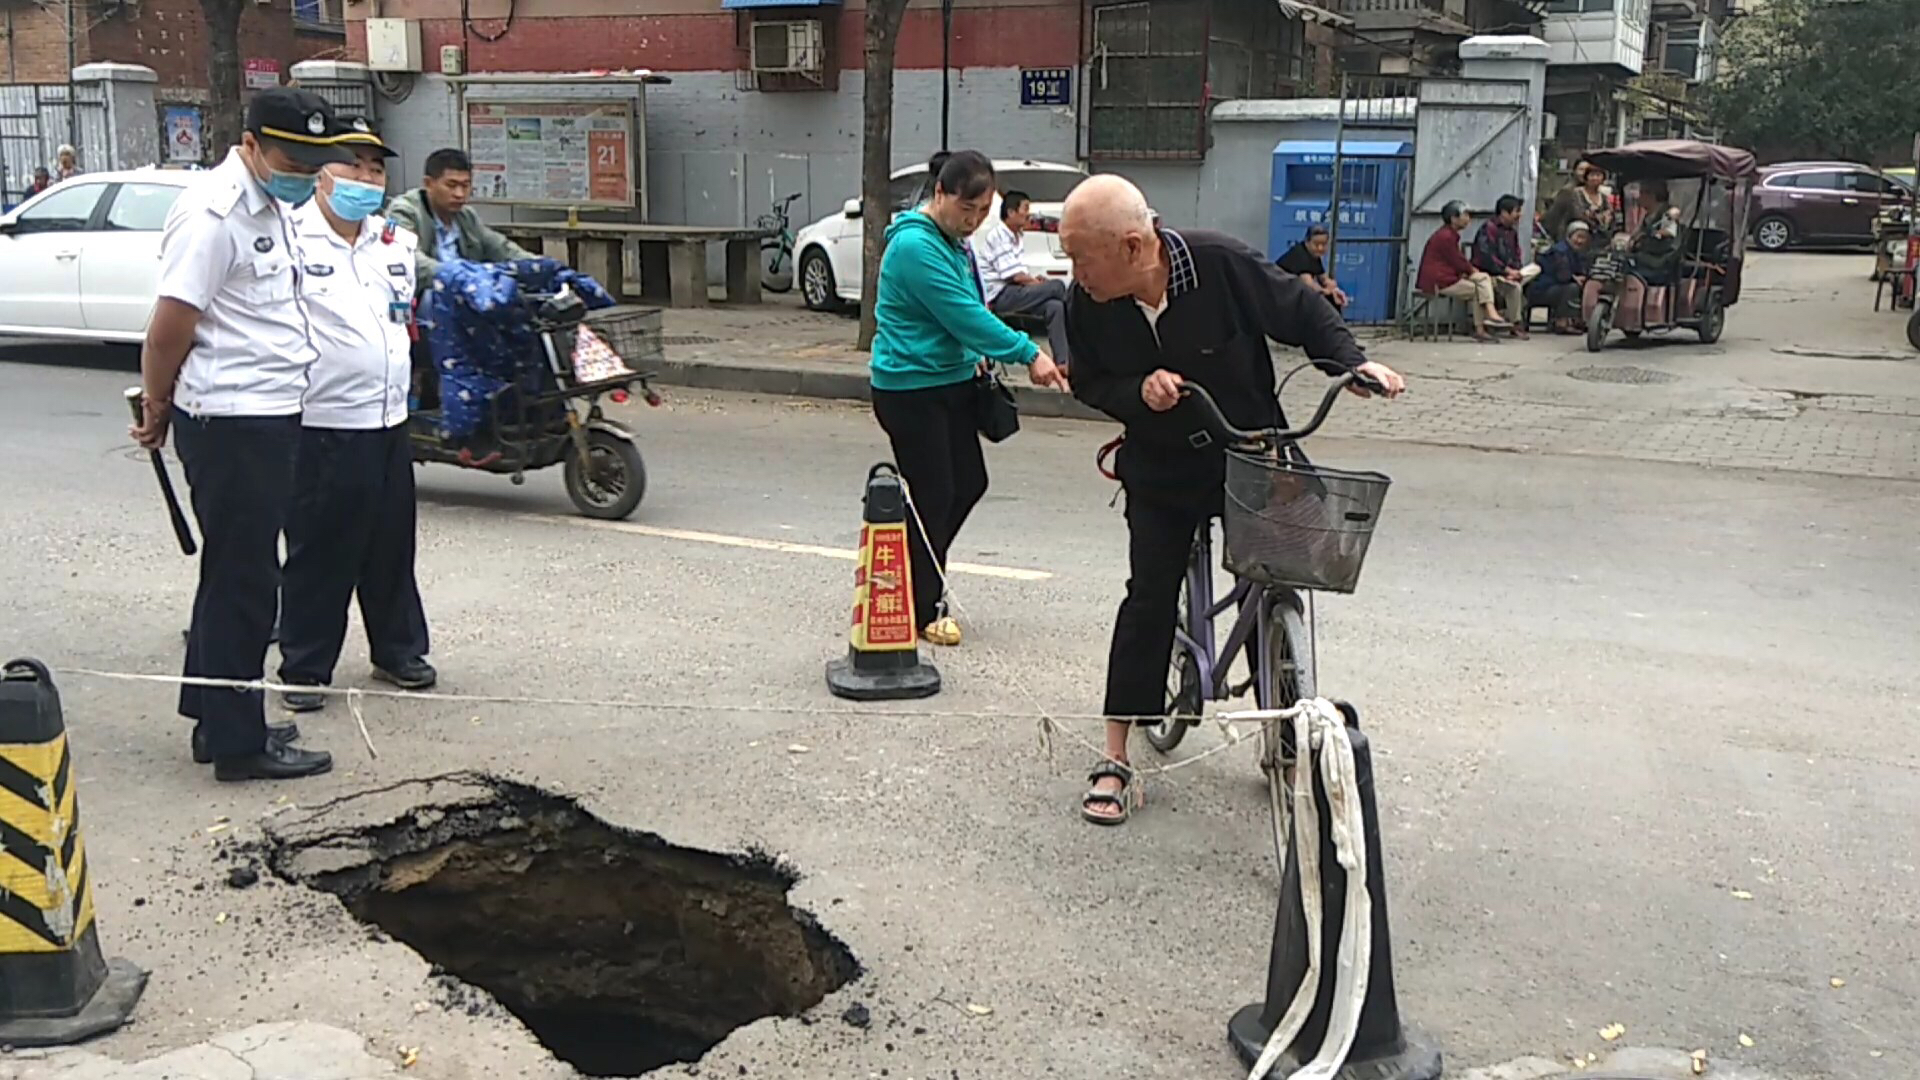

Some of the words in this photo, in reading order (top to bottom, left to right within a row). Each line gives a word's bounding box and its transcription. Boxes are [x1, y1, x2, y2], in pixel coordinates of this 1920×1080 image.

[1028, 80, 1045, 97] 19
[597, 145, 615, 165] 21
[875, 544, 896, 613] 牛癣
